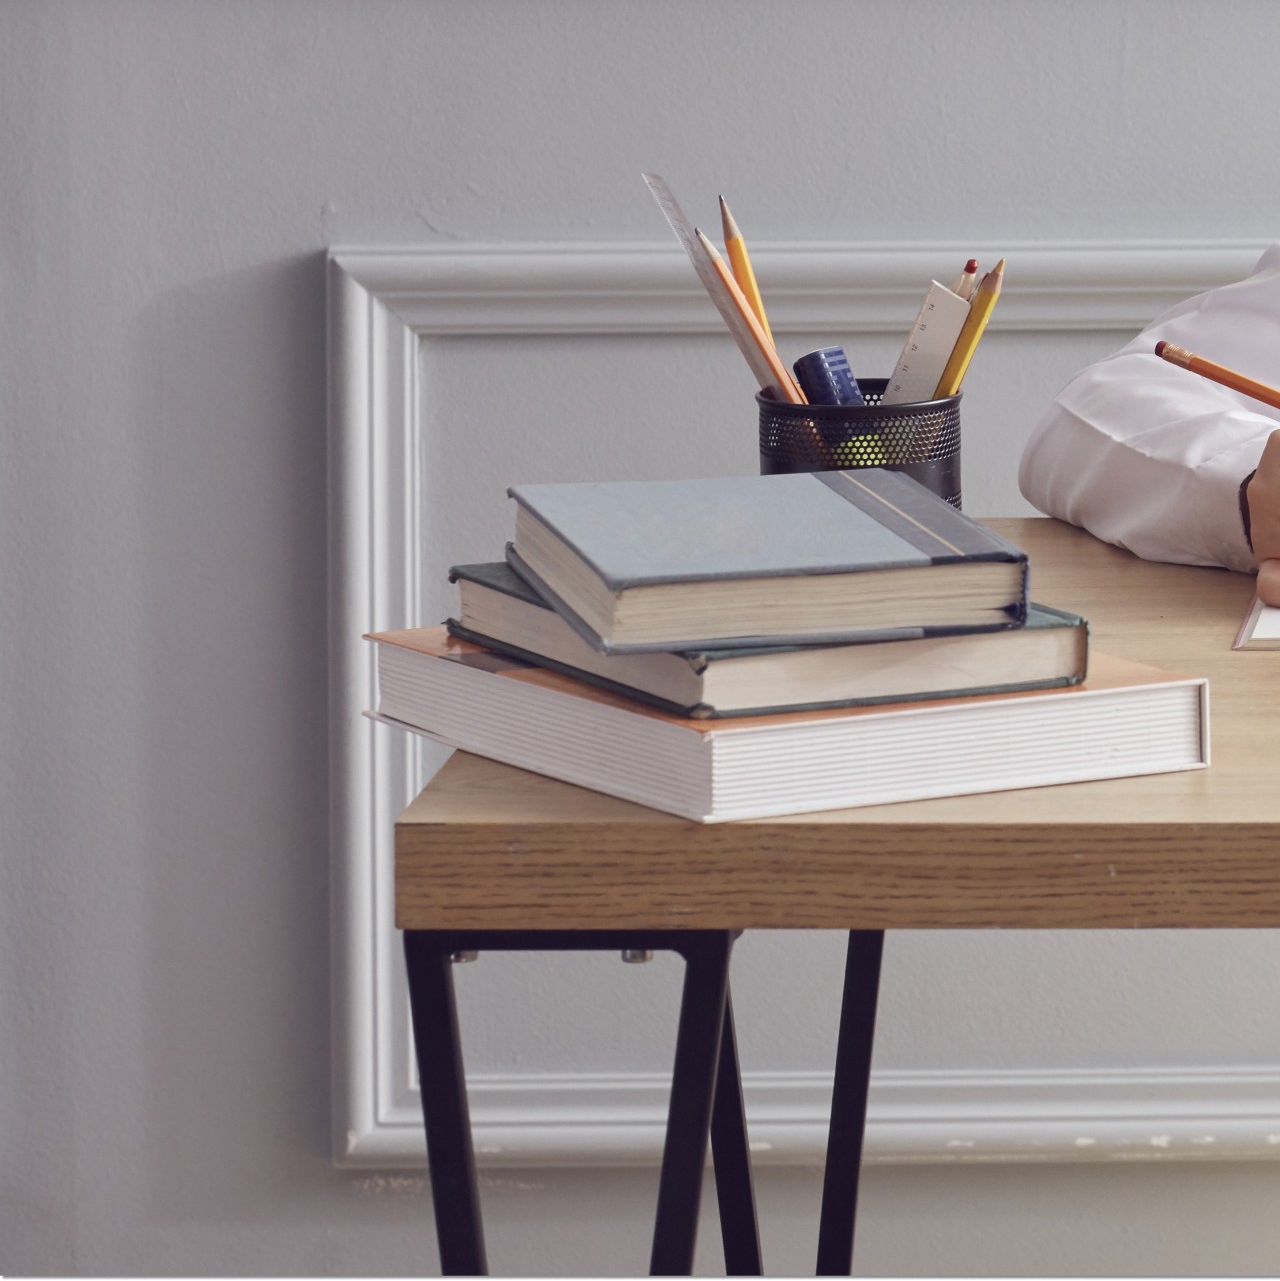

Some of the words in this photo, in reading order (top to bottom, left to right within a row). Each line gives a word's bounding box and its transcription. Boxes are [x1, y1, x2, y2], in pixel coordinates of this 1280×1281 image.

[911, 344, 919, 352] 12
[919, 323, 927, 331] 13
[928, 303, 936, 311] 14
